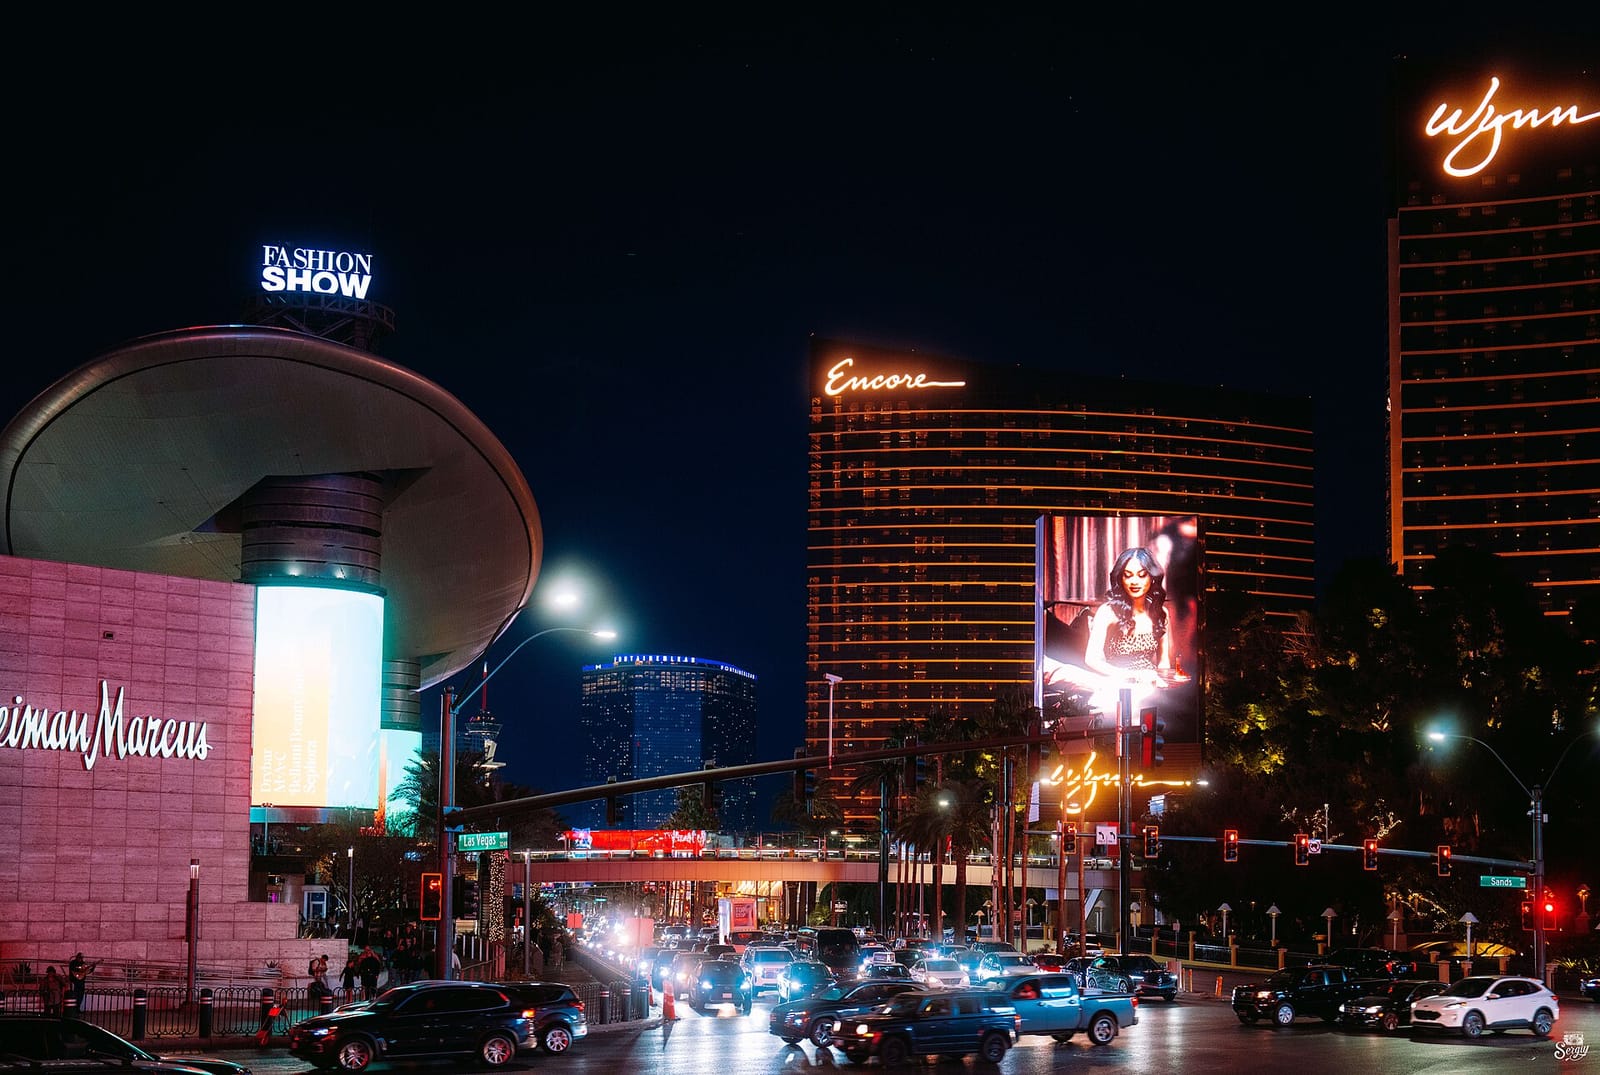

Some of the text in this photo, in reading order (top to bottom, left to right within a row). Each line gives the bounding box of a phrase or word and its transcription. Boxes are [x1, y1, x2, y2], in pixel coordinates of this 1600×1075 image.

[262, 245, 373, 275] FASHION
[261, 266, 372, 299] SHOW
[825, 358, 966, 396] Encore
[84, 680, 213, 770] Marcus
[260, 748, 273, 793] Drybar
[304, 740, 319, 793] Sephora
[463, 834, 475, 847] Las
[476, 833, 496, 849] Vegas
[1491, 877, 1512, 887] Sands
